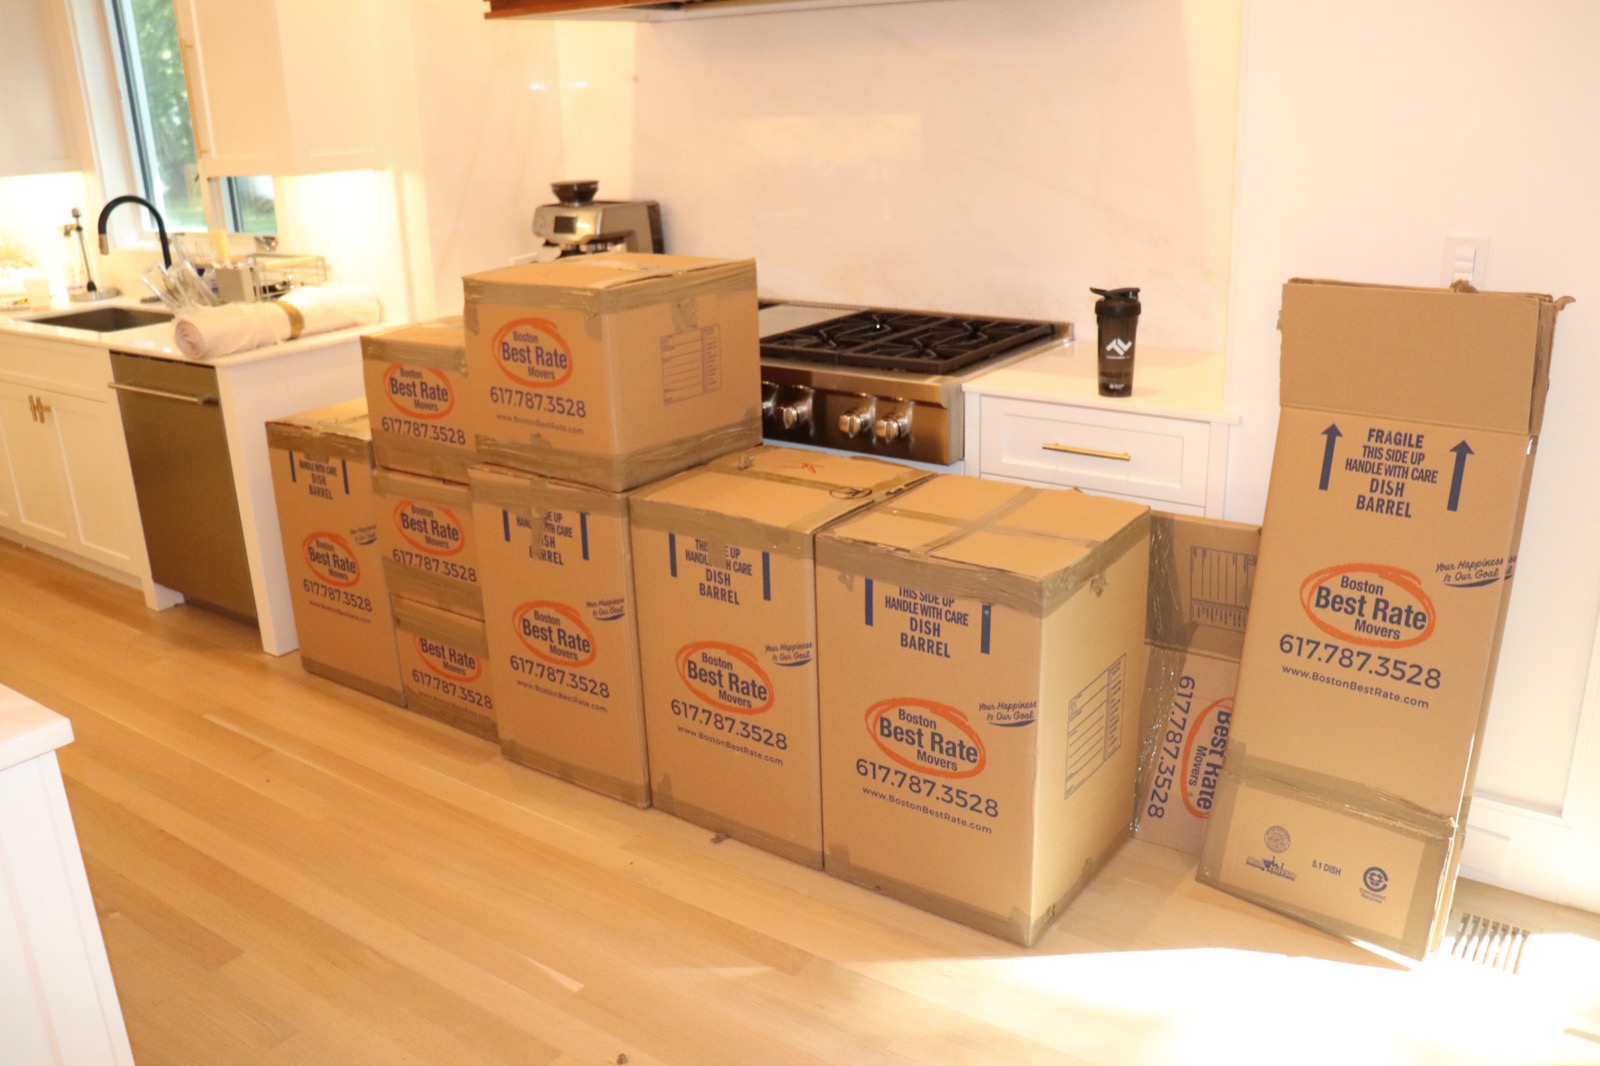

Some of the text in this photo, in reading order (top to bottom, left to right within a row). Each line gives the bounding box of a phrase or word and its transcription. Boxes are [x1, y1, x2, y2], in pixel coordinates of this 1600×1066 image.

[513, 331, 539, 343] Boston
[502, 342, 567, 369] Best Rate
[528, 366, 555, 380] Movers
[390, 377, 449, 402] Best Rate
[490, 386, 587, 418] 617.787.3528
[382, 416, 466, 445] 617.787.3528
[1367, 428, 1425, 449] FRAGILE
[1362, 445, 1425, 466] THIS SIDE UP
[1345, 458, 1439, 484] HANDLE WITH CARE
[309, 485, 333, 500] BARREL
[1369, 478, 1405, 497] DISH
[1356, 494, 1412, 518] BARREL
[401, 512, 459, 541] Best Rate
[556, 525, 573, 538] CARE
[308, 546, 356, 574] Best Rate
[529, 545, 564, 566] RREL
[685, 549, 712, 566] HANDL
[732, 561, 753, 576] CARE
[730, 547, 741, 559] UP
[1435, 563, 1456, 573] Your
[1457, 557, 1504, 571] Happiness
[392, 549, 477, 583] 617.787.3528
[706, 568, 731, 587] DISH
[1443, 573, 1452, 582] Is
[1454, 572, 1472, 581] Our
[1474, 568, 1499, 579] Goal
[303, 579, 373, 613] 617.787.3528
[699, 582, 740, 606] BARREL
[1340, 575, 1384, 596] Boston
[533, 610, 561, 626] Boston
[885, 595, 969, 627] HANDLE WITH CARE
[1314, 585, 1427, 631] Best Rate
[522, 618, 591, 654] Best Rate
[910, 616, 941, 637] DISH
[1354, 618, 1401, 640] Movers
[420, 637, 476, 670] Best Rate
[549, 644, 579, 661] Movers
[900, 632, 951, 659] BARREL
[701, 651, 733, 671] Boston
[1279, 633, 1441, 690] 617.787.3528
[412, 669, 493, 710] 617.787.3528
[510, 655, 610, 699] 617.787.3528
[687, 659, 768, 701] Best Rate
[1282, 664, 1429, 709] www.BostonBestRate.com
[718, 689, 752, 709] Movers
[978, 701, 1037, 712] Your Happiness
[671, 698, 788, 751] 617.787.3528
[898, 708, 937, 730] Boston
[986, 710, 1034, 721] Is Our Goal
[677, 725, 784, 766] www.BostonBestRate.com
[880, 716, 978, 764] Best Rate
[1147, 675, 1196, 819] 617.787.3528
[917, 749, 958, 771] Movers
[1189, 745, 1208, 787] Movers
[856, 758, 999, 818] 617.787.3528
[862, 786, 992, 835] www.BostonBestRate.com
[1323, 862, 1342, 876] DISH
